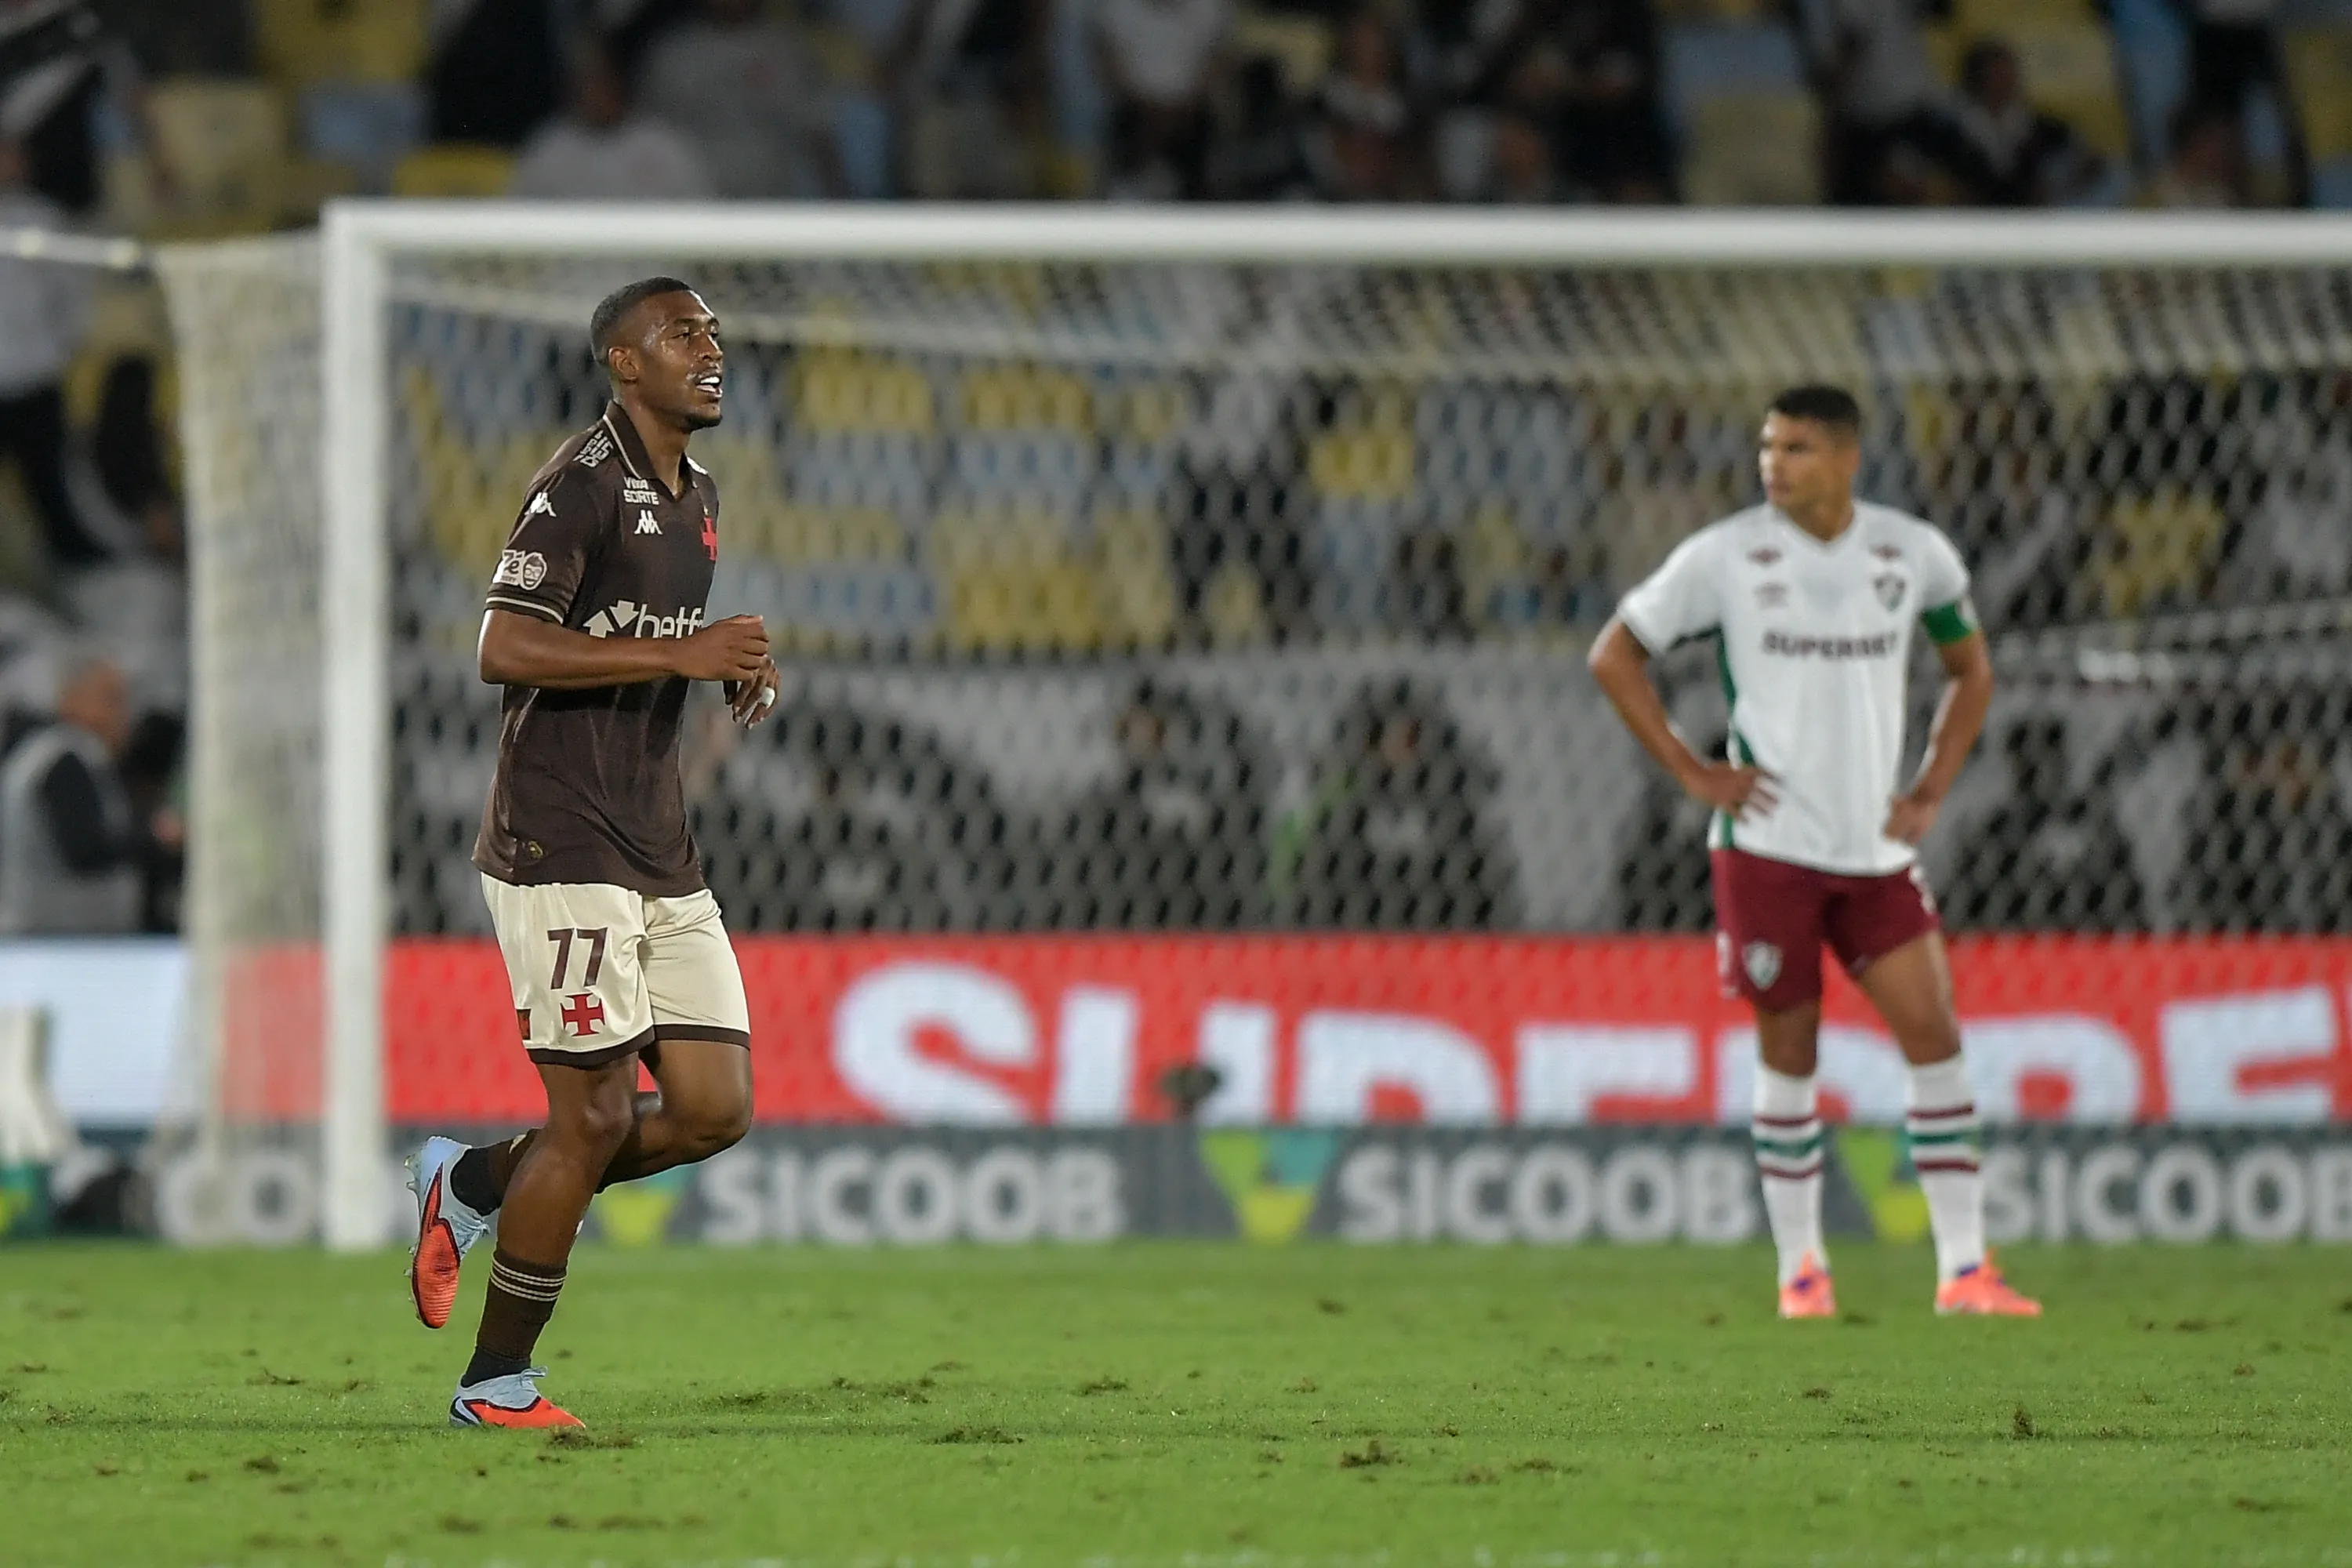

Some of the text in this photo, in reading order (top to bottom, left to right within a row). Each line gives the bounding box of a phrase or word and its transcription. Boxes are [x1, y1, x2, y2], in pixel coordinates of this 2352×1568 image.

[623, 489, 659, 506] SORTE
[634, 603, 704, 638] betf
[546, 927, 608, 990] 77
[702, 1146, 1124, 1245] SICOOB
[1339, 1145, 1756, 1244] SICOOB
